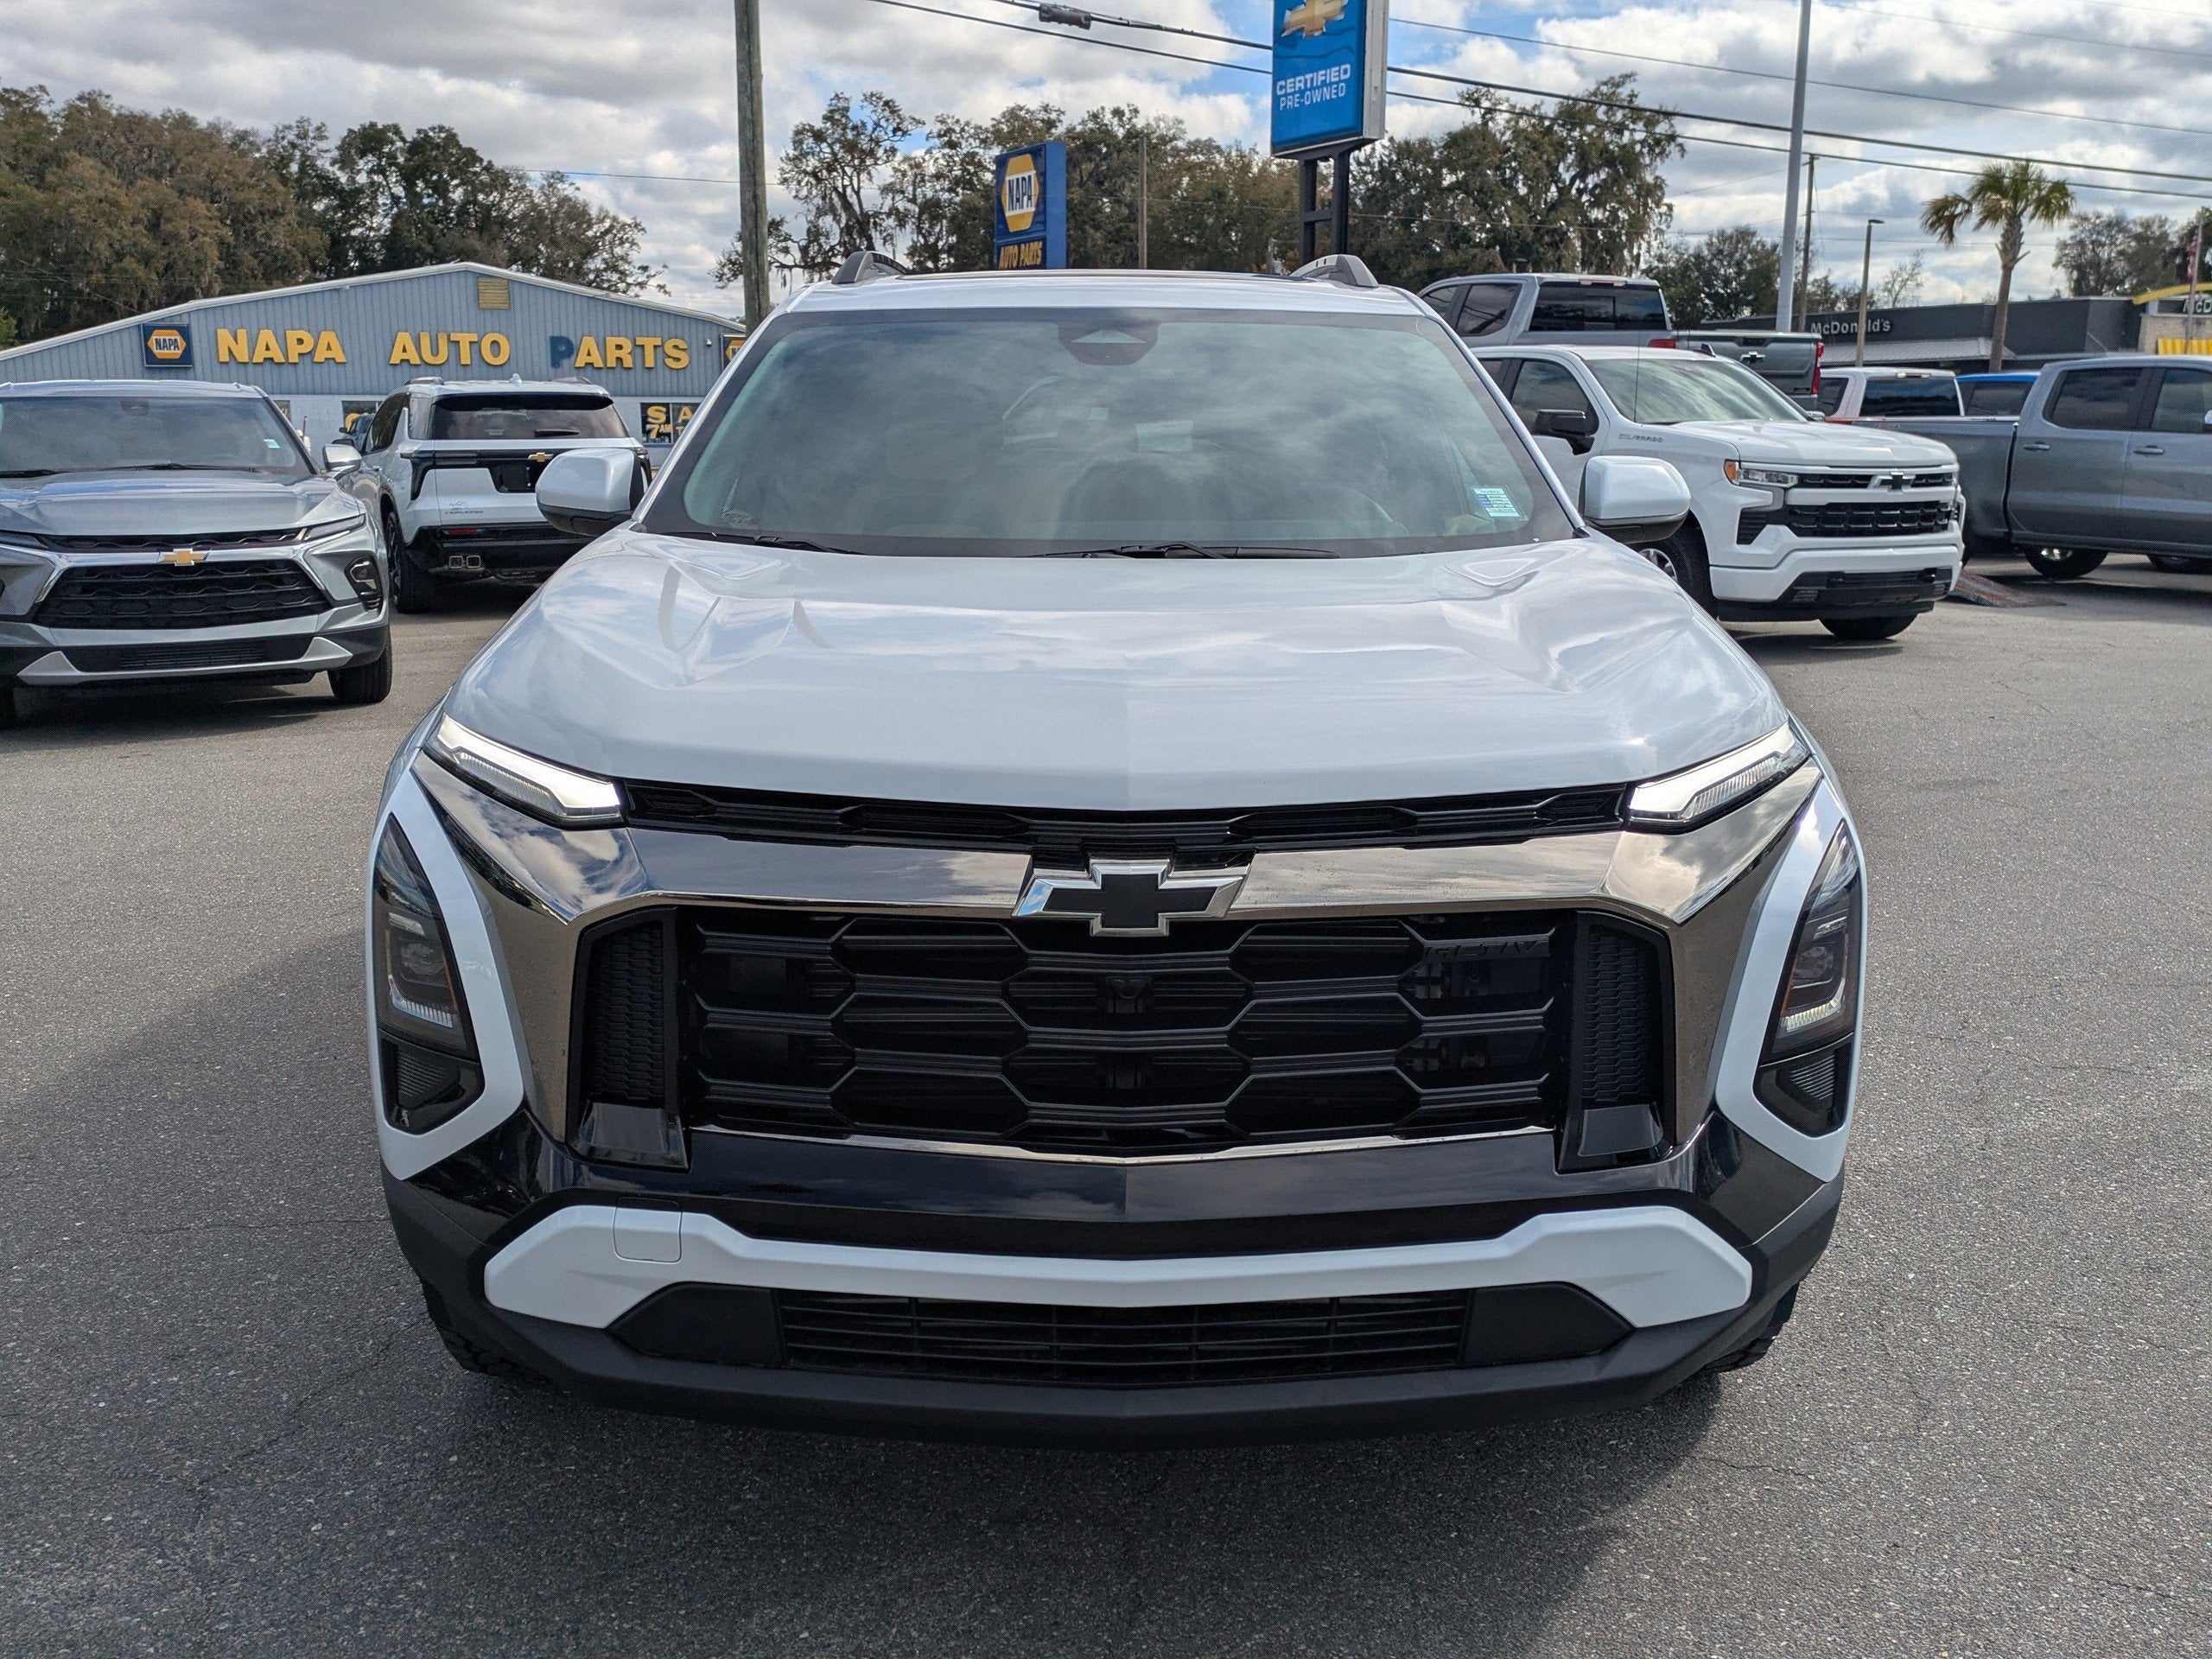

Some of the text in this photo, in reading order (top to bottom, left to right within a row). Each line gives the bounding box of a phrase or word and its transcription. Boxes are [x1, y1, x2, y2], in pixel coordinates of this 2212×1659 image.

[1276, 63, 1351, 95] CERTIFIED
[1280, 82, 1346, 111] PRE-OWNED
[1007, 175, 1033, 212] NAPA
[999, 241, 1043, 270] AUTO PARTS
[1810, 318, 1891, 335] McDonld's
[155, 338, 180, 352] NAPA
[216, 328, 690, 370] NAPA AUTO PARTS
